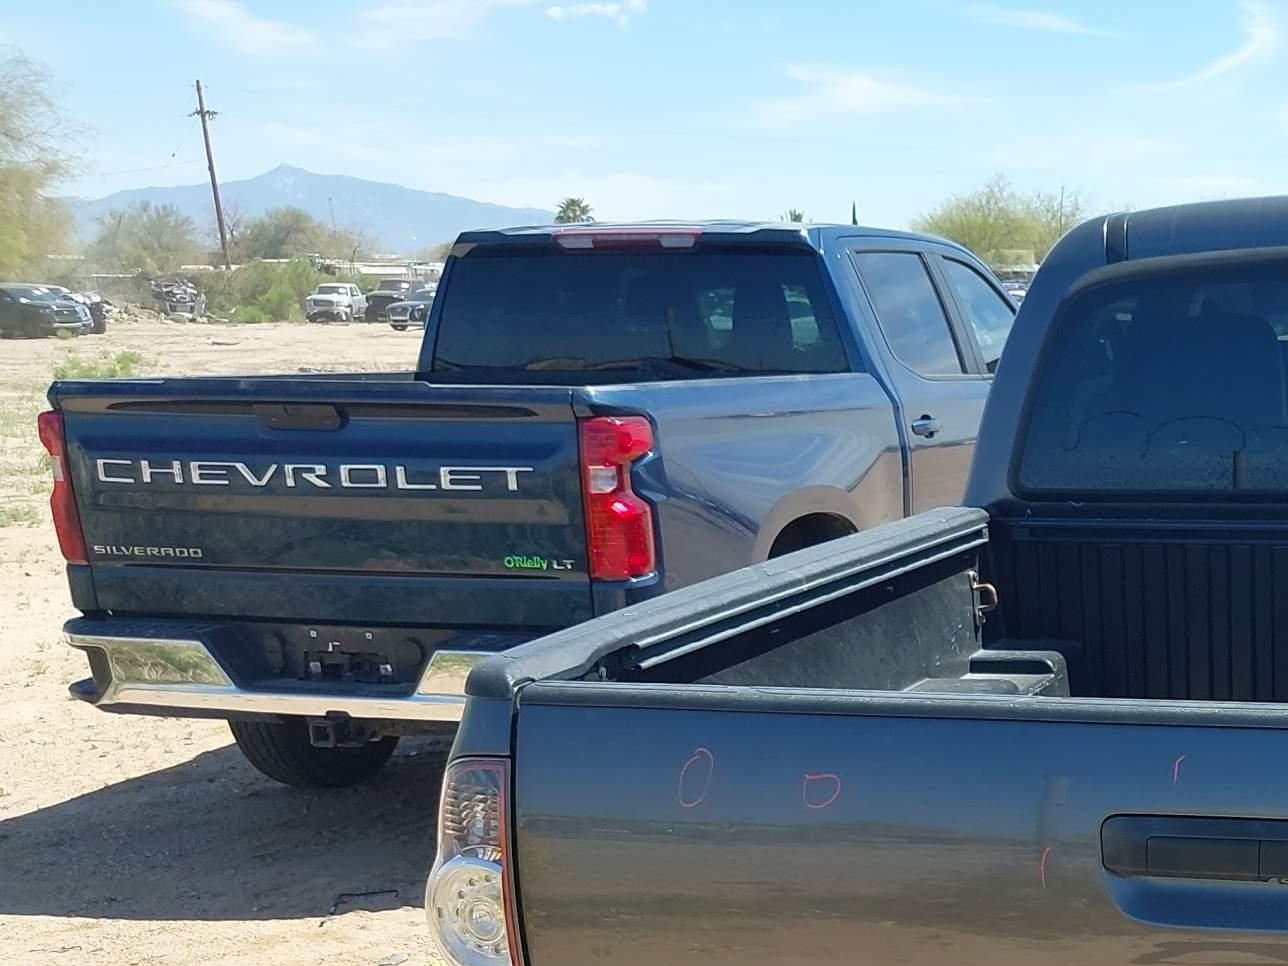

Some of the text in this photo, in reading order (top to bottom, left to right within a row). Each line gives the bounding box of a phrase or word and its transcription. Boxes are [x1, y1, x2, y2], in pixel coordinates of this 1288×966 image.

[96, 458, 534, 491] CHEVROLET
[93, 544, 203, 559] SILVERADO
[552, 559, 576, 570] LT
